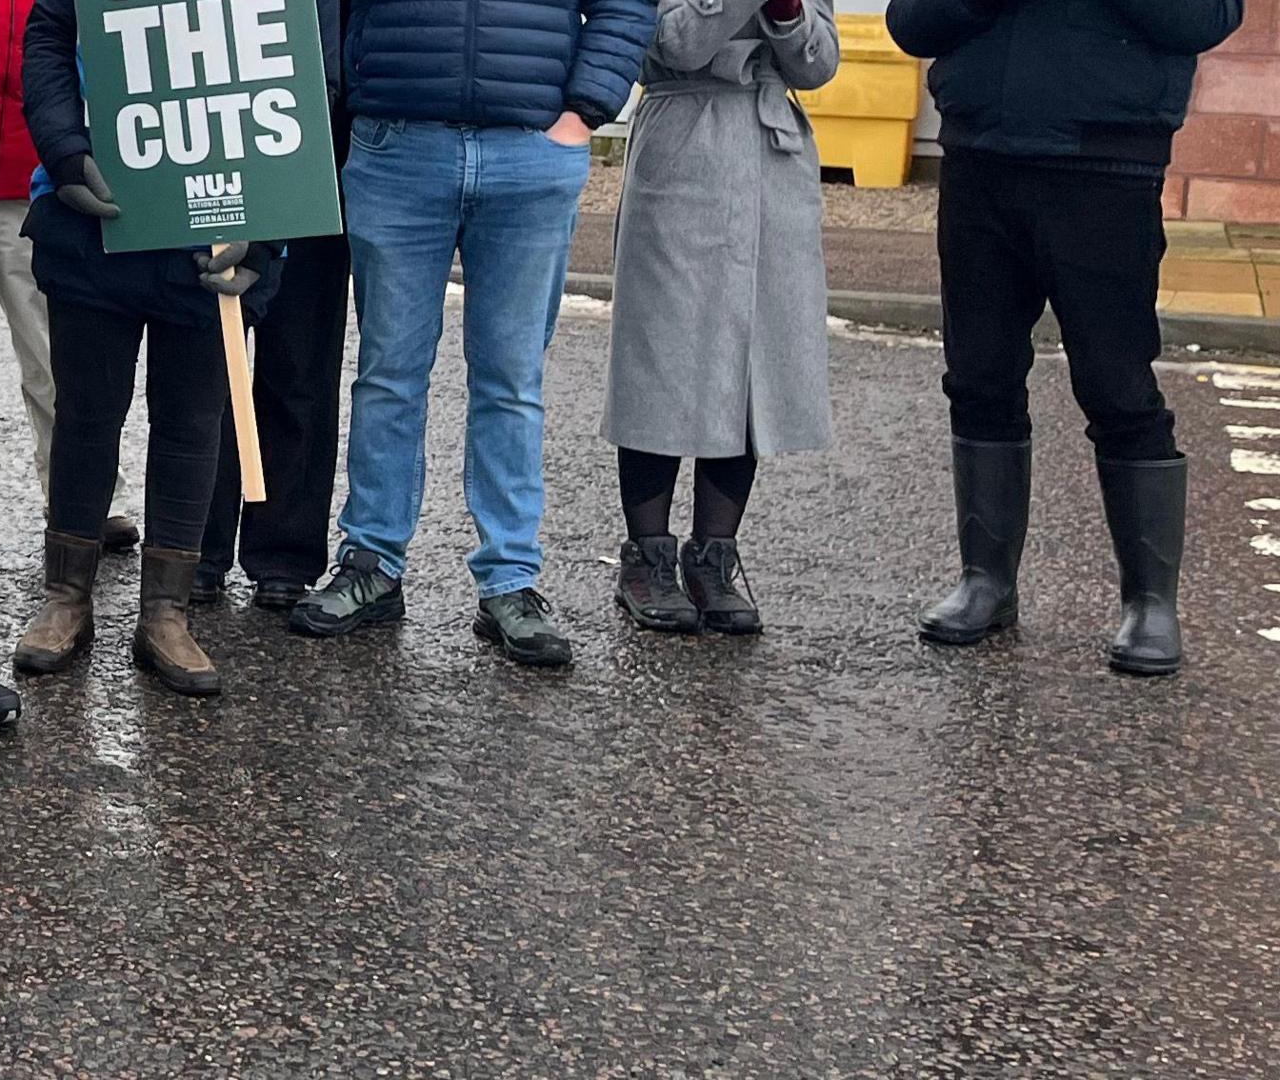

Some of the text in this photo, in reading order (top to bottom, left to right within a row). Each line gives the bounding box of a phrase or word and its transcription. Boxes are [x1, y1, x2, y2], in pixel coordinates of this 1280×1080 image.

[116, 87, 302, 170] CUTS
[185, 171, 242, 199] NUJ
[189, 212, 245, 224] JOURNALISTS
